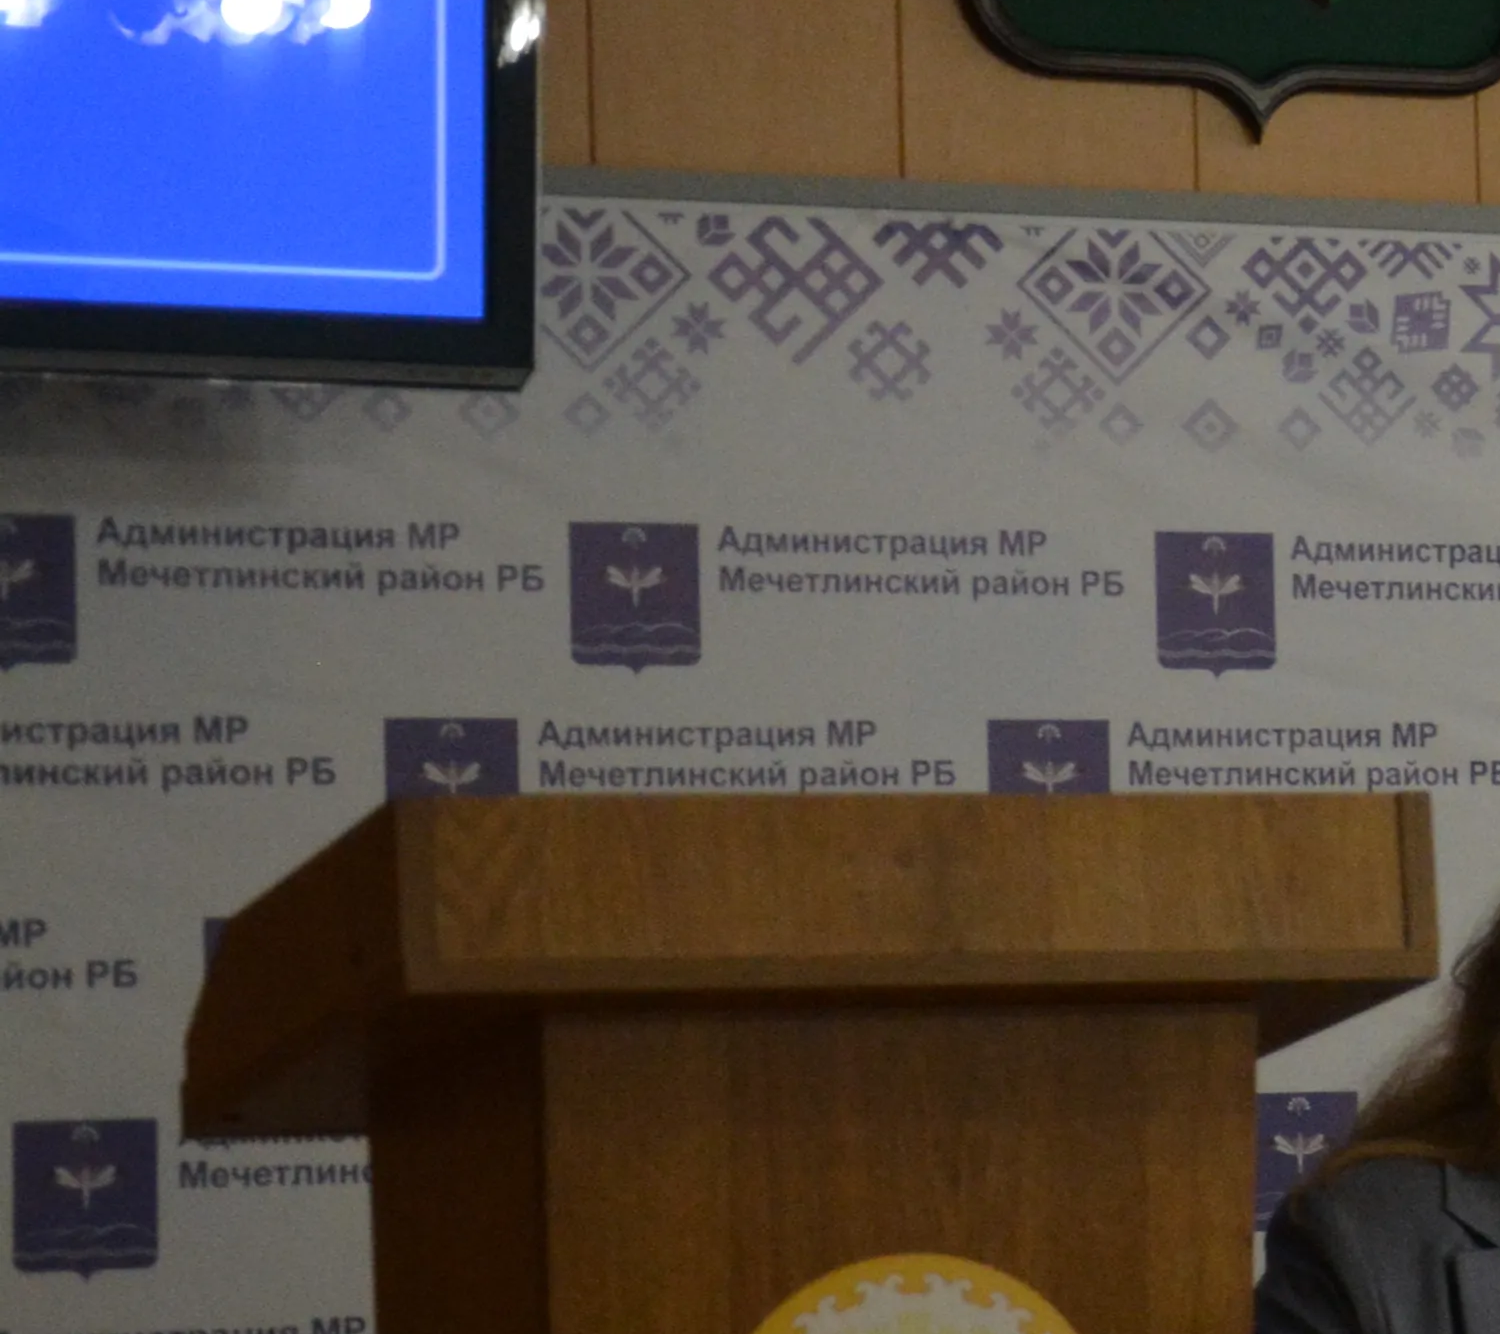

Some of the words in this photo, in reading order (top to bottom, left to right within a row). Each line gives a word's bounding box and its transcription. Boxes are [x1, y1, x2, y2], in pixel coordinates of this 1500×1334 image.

[97, 516, 395, 553] Администрация
[408, 522, 460, 549] МР
[717, 525, 987, 560] Администрация
[998, 530, 1047, 555] МР
[97, 560, 364, 592] Мечетлинский
[378, 561, 485, 595] район
[498, 564, 545, 593] РБ
[718, 565, 961, 597] Мечетлинский
[972, 569, 1069, 601] район
[1082, 570, 1124, 596] РБ
[193, 717, 248, 743] МР
[538, 719, 814, 752] Администрация
[826, 720, 877, 746] МР
[1128, 720, 1381, 752] Администрация
[1391, 722, 1437, 748] МР
[162, 757, 273, 790] район
[287, 757, 336, 785] РБ
[539, 759, 786, 788] Мечетлинский
[800, 759, 900, 793] район
[912, 761, 956, 787] РБ
[1128, 759, 1356, 787] Мечетлинский
[1367, 760, 1458, 791] район
[86, 959, 137, 989] РБ
